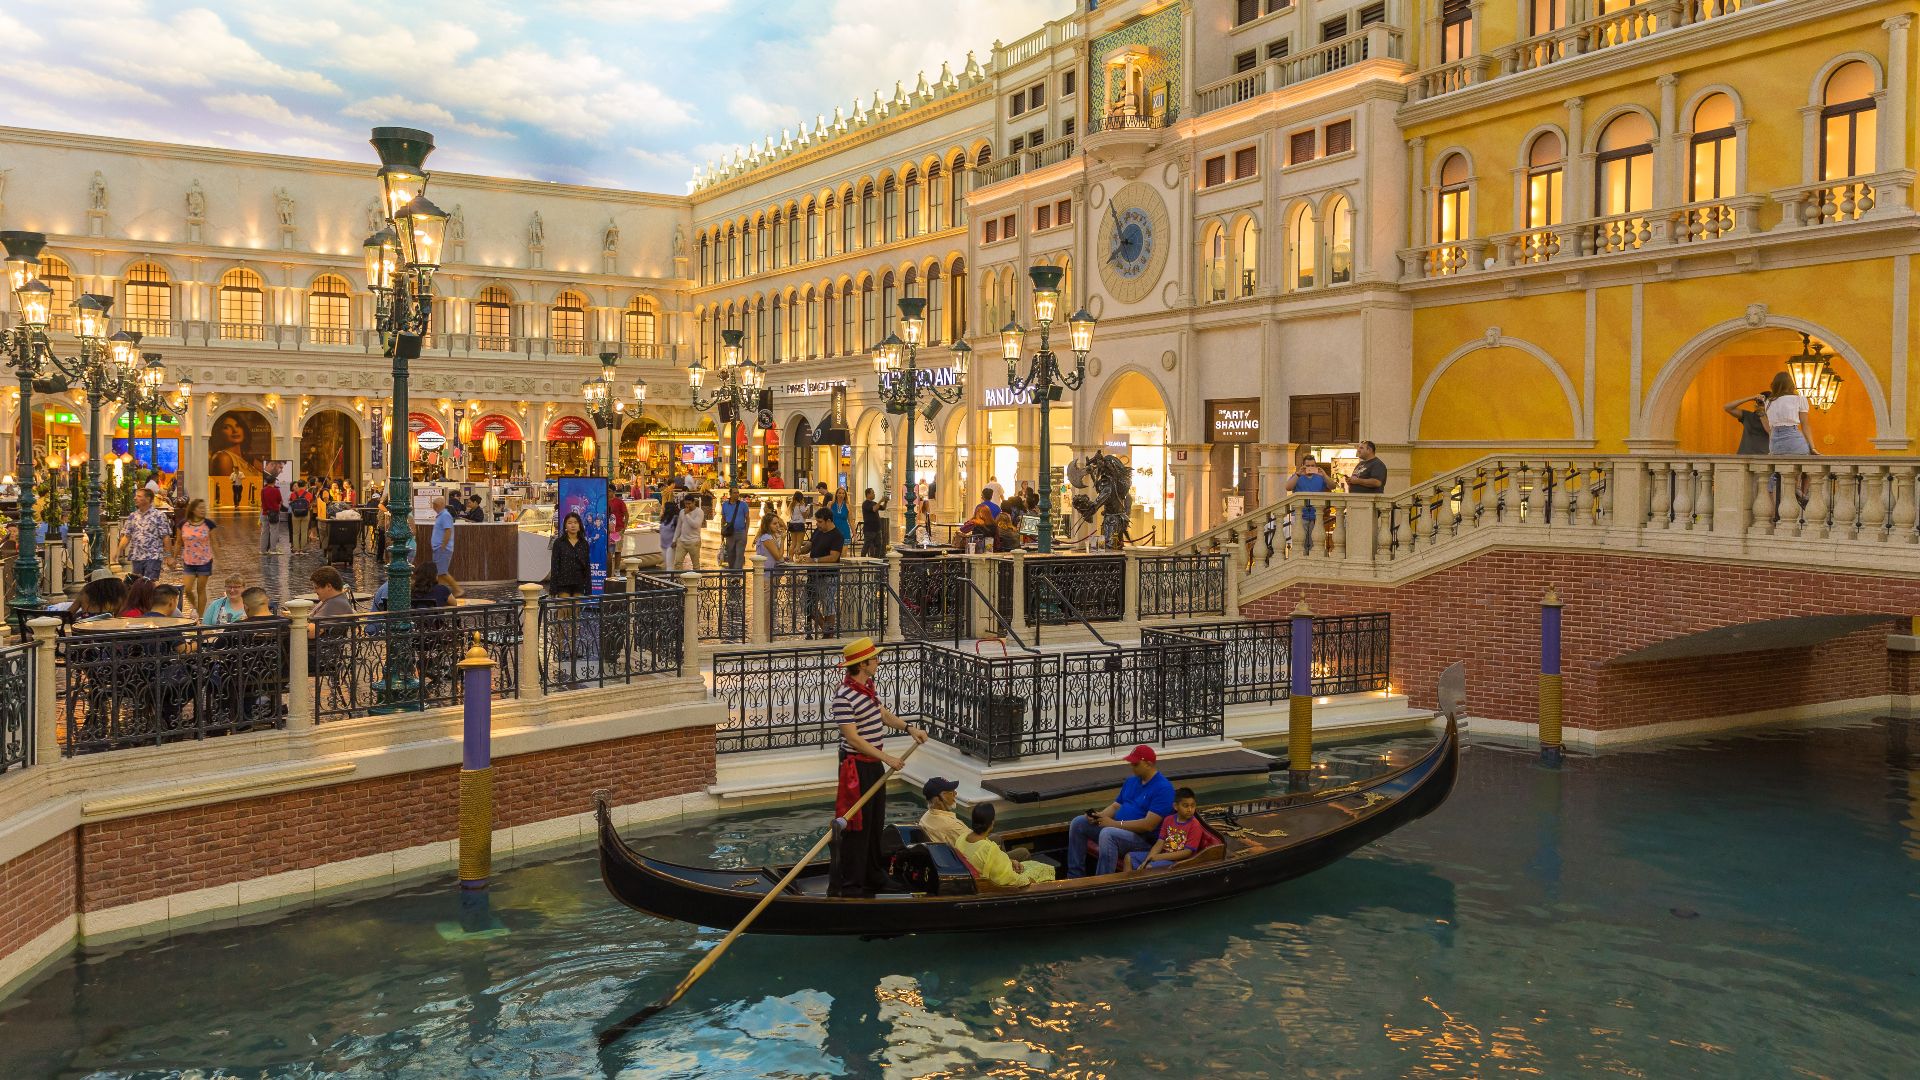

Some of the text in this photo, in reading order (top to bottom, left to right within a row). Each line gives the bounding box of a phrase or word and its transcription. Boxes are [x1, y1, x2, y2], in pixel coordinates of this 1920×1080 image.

[786, 383, 806, 394] PARIS
[985, 385, 1036, 406] PANDOR
[1224, 410, 1245, 420] ART
[1215, 419, 1259, 430] SHAVING
[914, 459, 934, 468] ALEX
